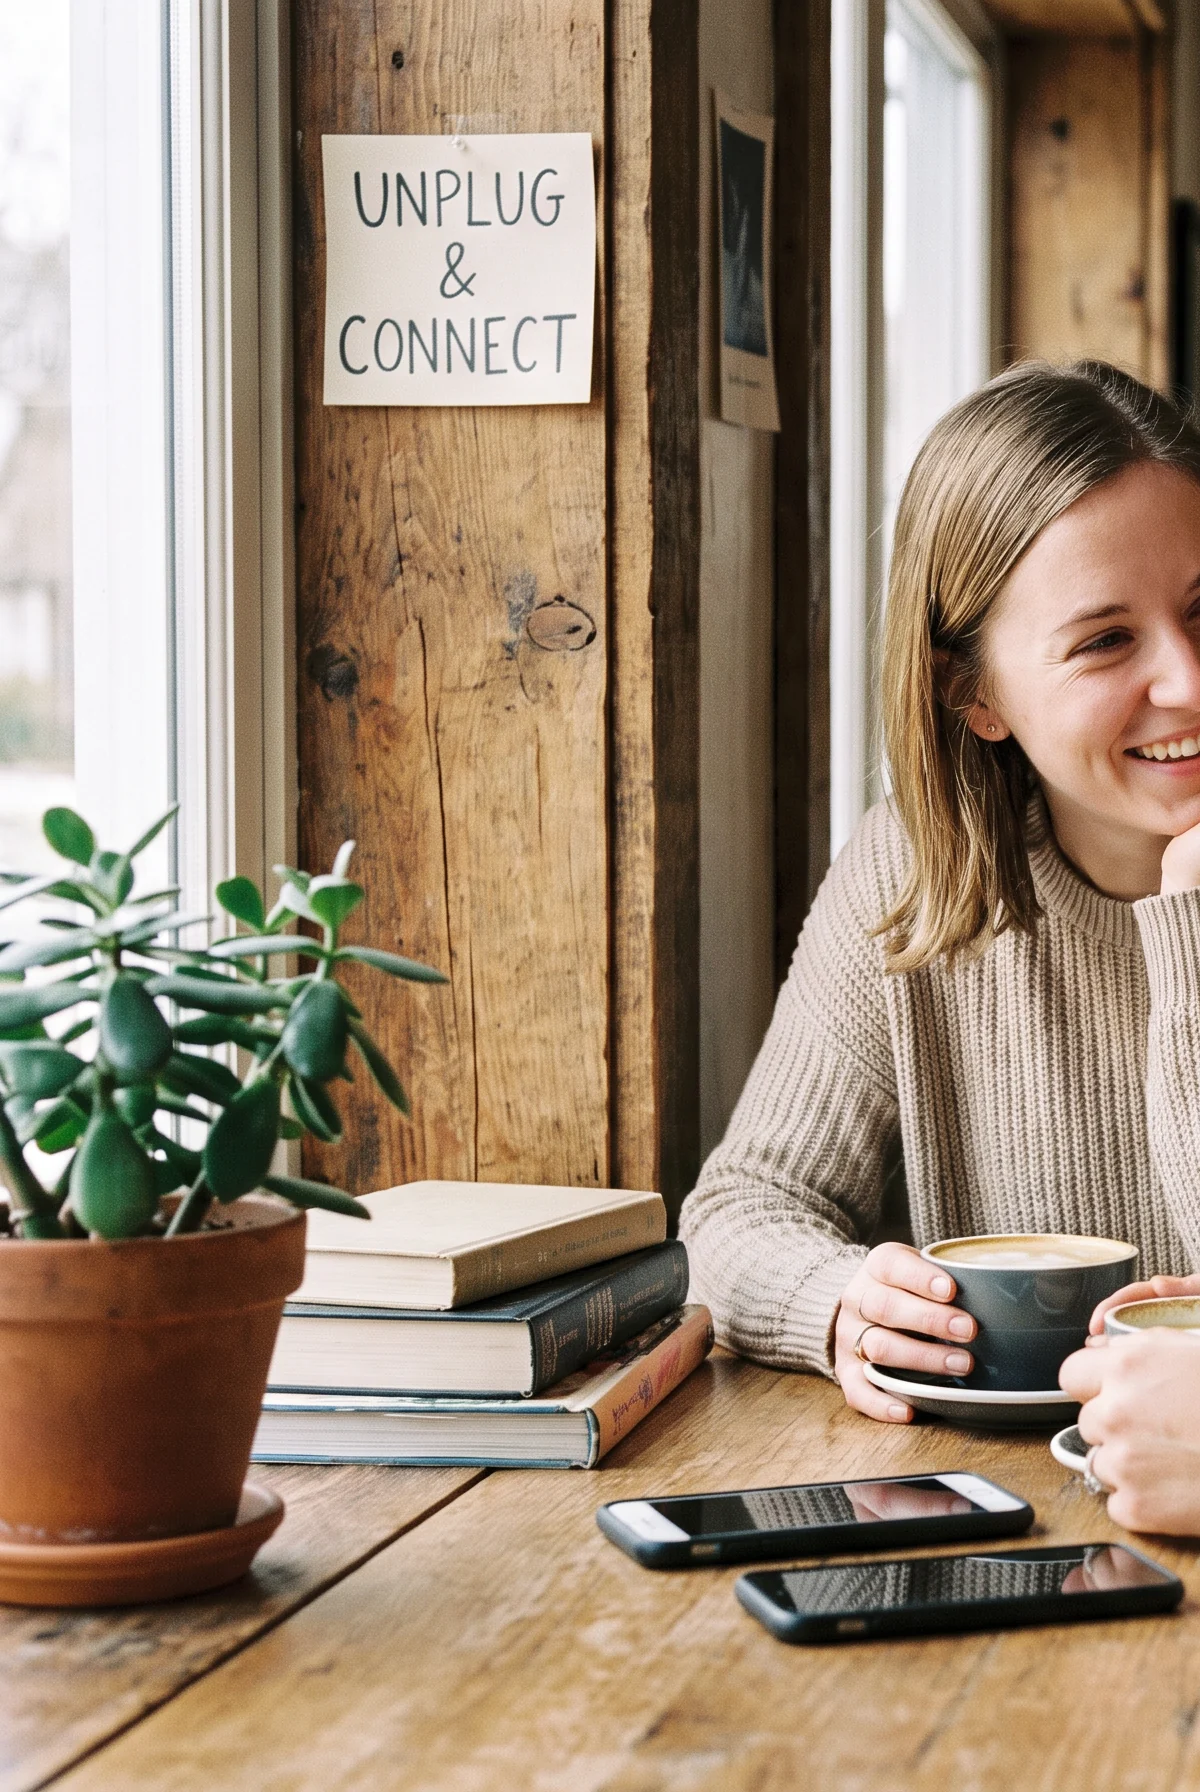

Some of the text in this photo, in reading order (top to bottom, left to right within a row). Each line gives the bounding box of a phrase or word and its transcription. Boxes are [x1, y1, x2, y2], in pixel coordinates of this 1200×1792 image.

[354, 168, 565, 228] UNPLUG
[439, 241, 477, 299] &
[338, 313, 577, 375] CONNECT
